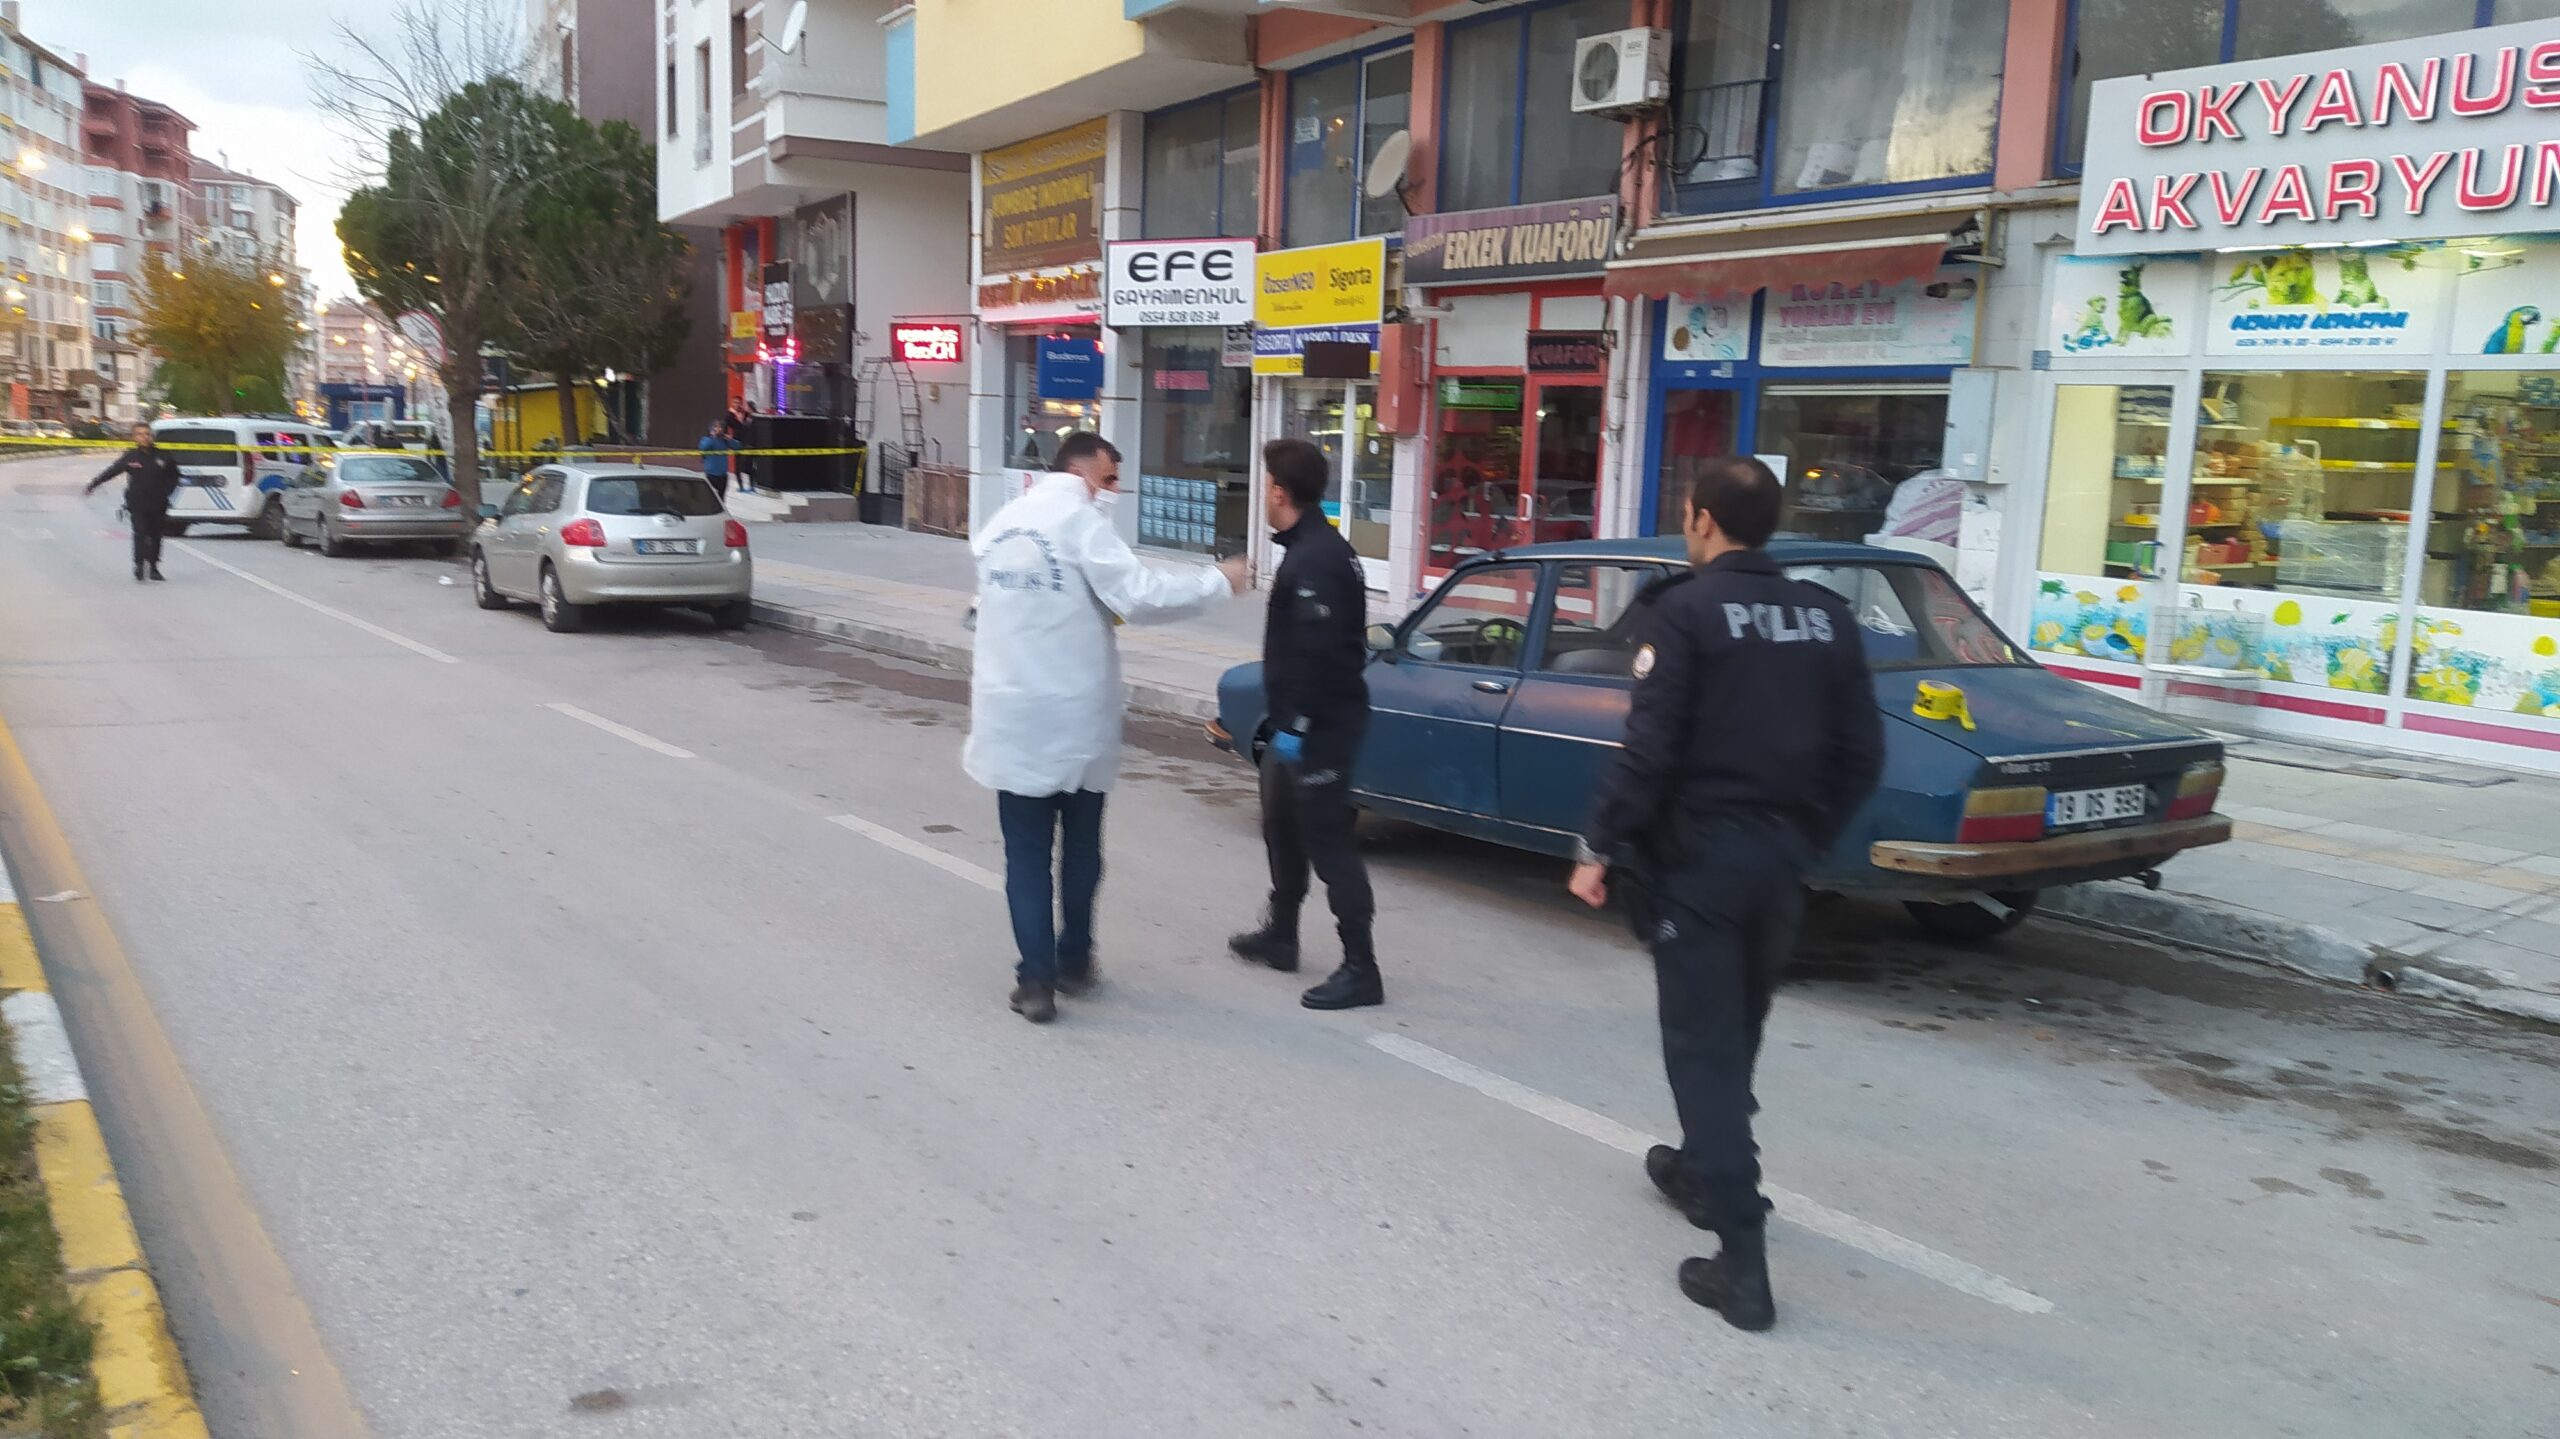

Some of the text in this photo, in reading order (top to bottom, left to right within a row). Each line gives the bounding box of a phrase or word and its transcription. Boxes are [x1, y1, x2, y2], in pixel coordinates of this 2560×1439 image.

[2136, 41, 2560, 147] OKYANUS
[1442, 226, 1508, 270] ERKEK
[1508, 203, 1613, 265] KUAFÖRÜ
[1128, 249, 1235, 283] EFE
[1329, 267, 1372, 291] Sigorta
[1721, 602, 1835, 643] POLIS
